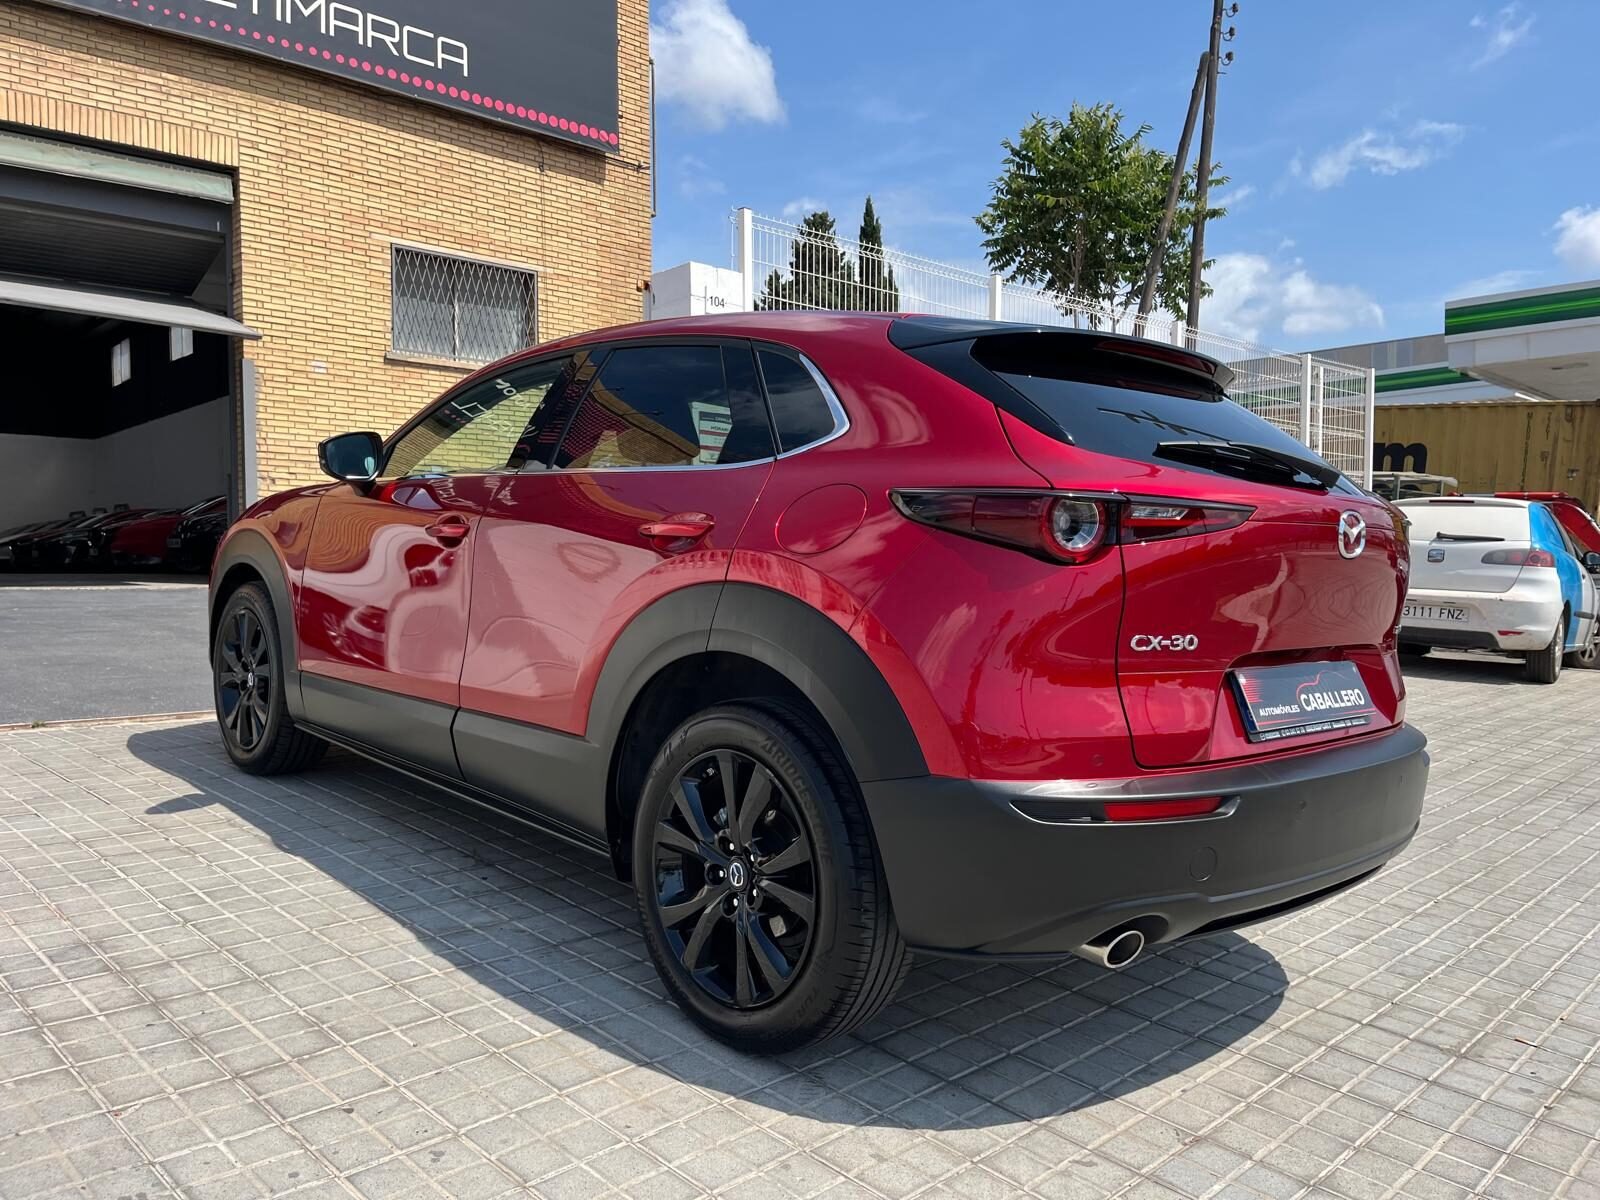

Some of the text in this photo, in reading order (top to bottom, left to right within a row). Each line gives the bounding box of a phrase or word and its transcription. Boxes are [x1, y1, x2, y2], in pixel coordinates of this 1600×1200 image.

[709, 296, 725, 308] 104
[1403, 605, 1463, 620] 3111 FNZ
[1130, 634, 1199, 651] CX-30
[1259, 688, 1365, 717] AUTOMÓVILES CABALLERO
